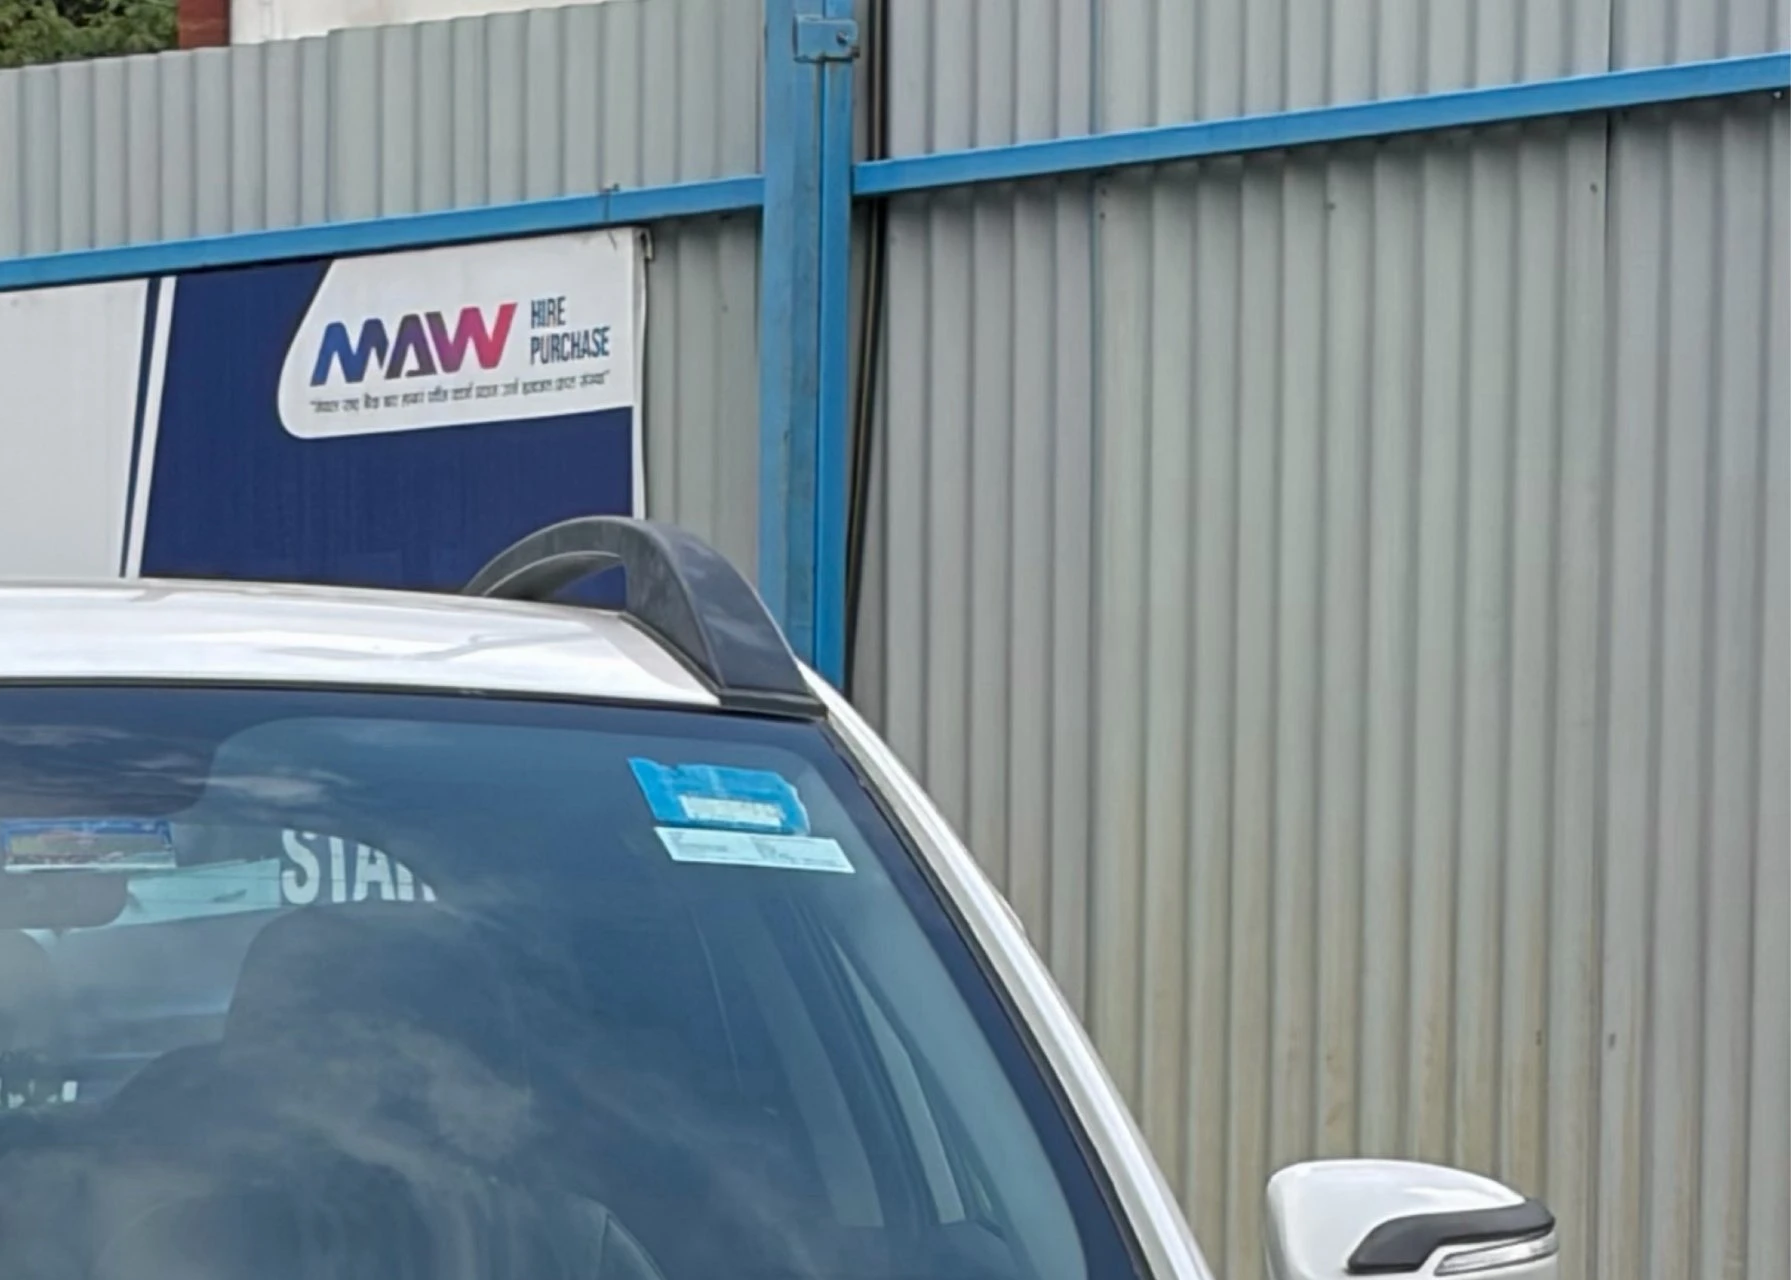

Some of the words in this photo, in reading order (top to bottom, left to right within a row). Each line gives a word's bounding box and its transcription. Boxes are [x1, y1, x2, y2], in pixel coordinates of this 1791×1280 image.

[530, 296, 566, 329] HIRE
[309, 302, 518, 387] MAW
[530, 325, 611, 365] PURCHASE
